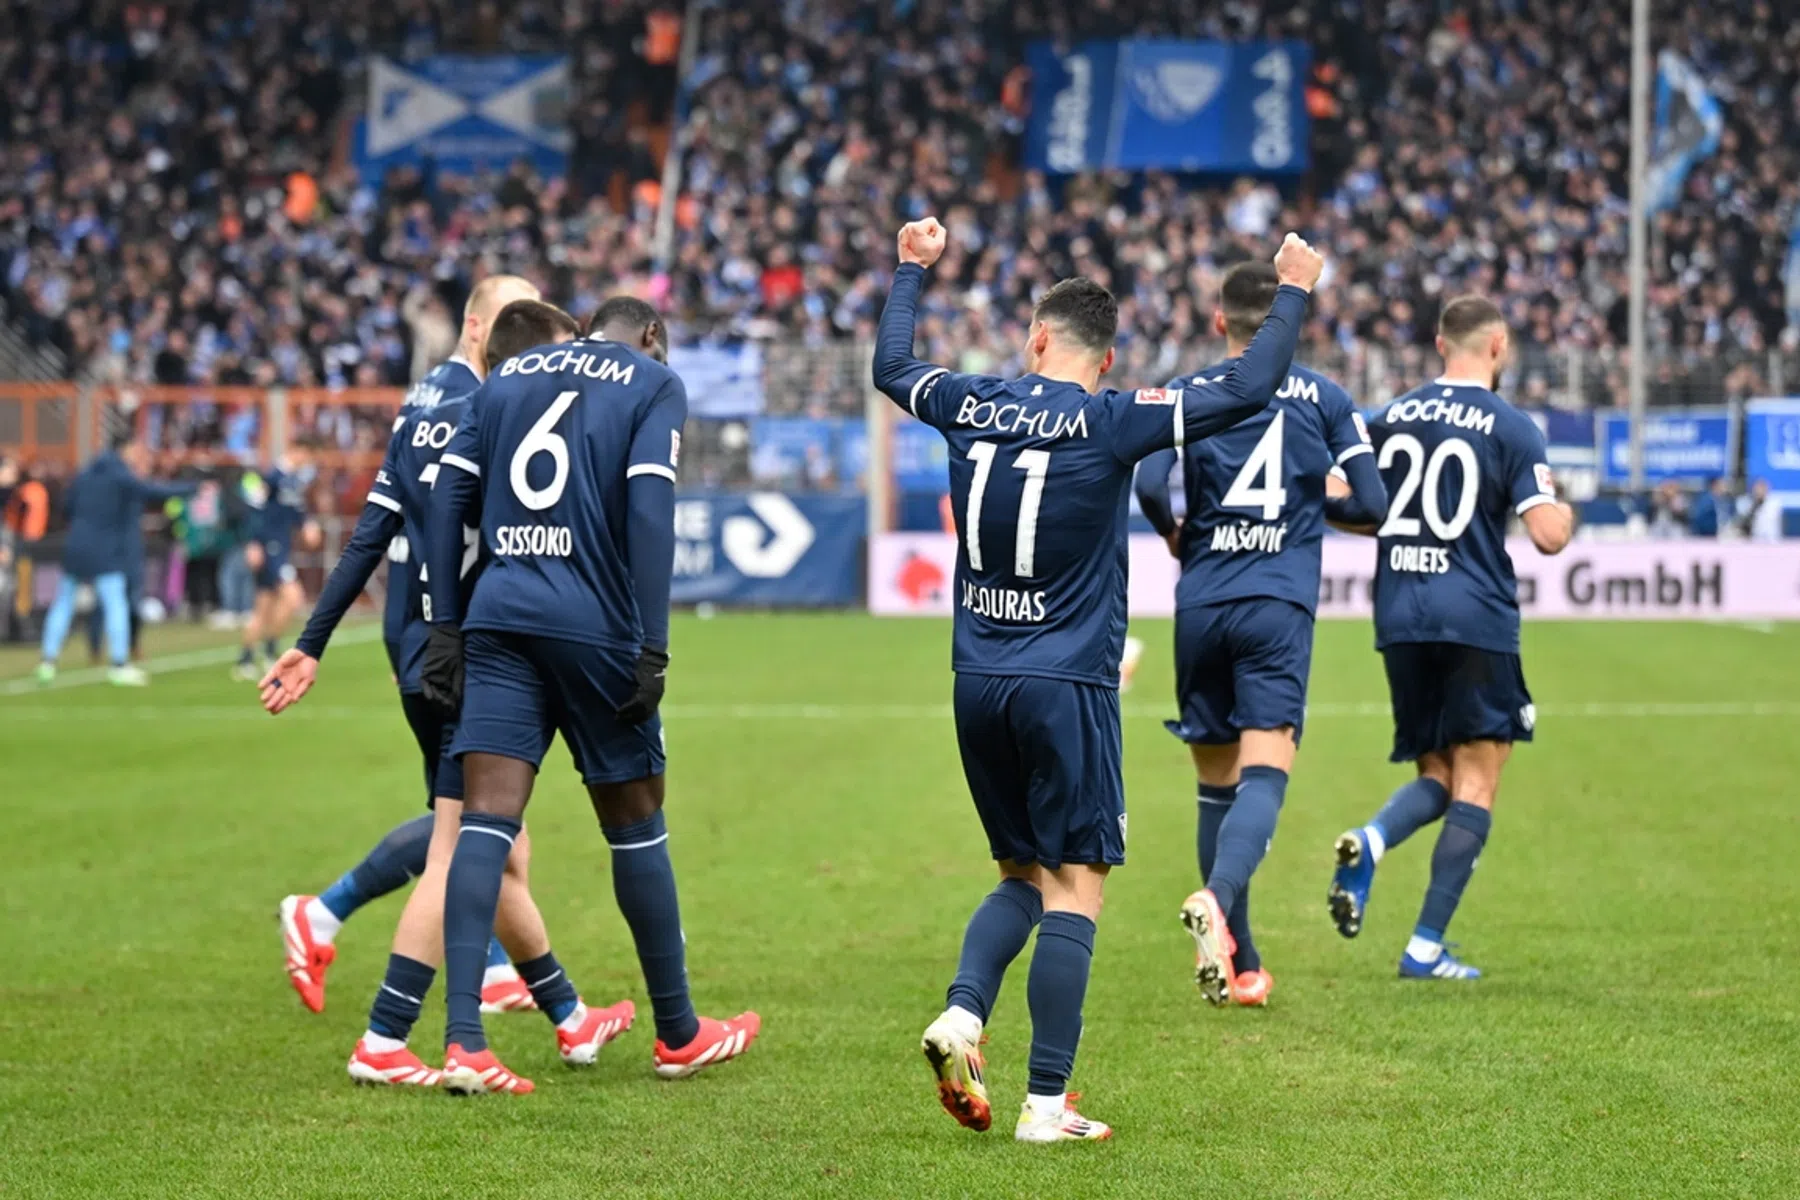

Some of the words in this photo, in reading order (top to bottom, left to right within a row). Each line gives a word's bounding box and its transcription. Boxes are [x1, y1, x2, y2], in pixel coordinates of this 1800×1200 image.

[500, 350, 635, 385] BOCHUM
[956, 395, 1088, 439] BOCHUM
[1386, 398, 1495, 435] BOCHUM
[510, 391, 579, 510] 6
[1221, 409, 1286, 520] 4
[966, 440, 1050, 578] 11
[1377, 433, 1479, 540] 20
[495, 525, 572, 557] SISSOKO
[1390, 544, 1450, 574] ORLETS
[1566, 560, 1722, 607] GmbH
